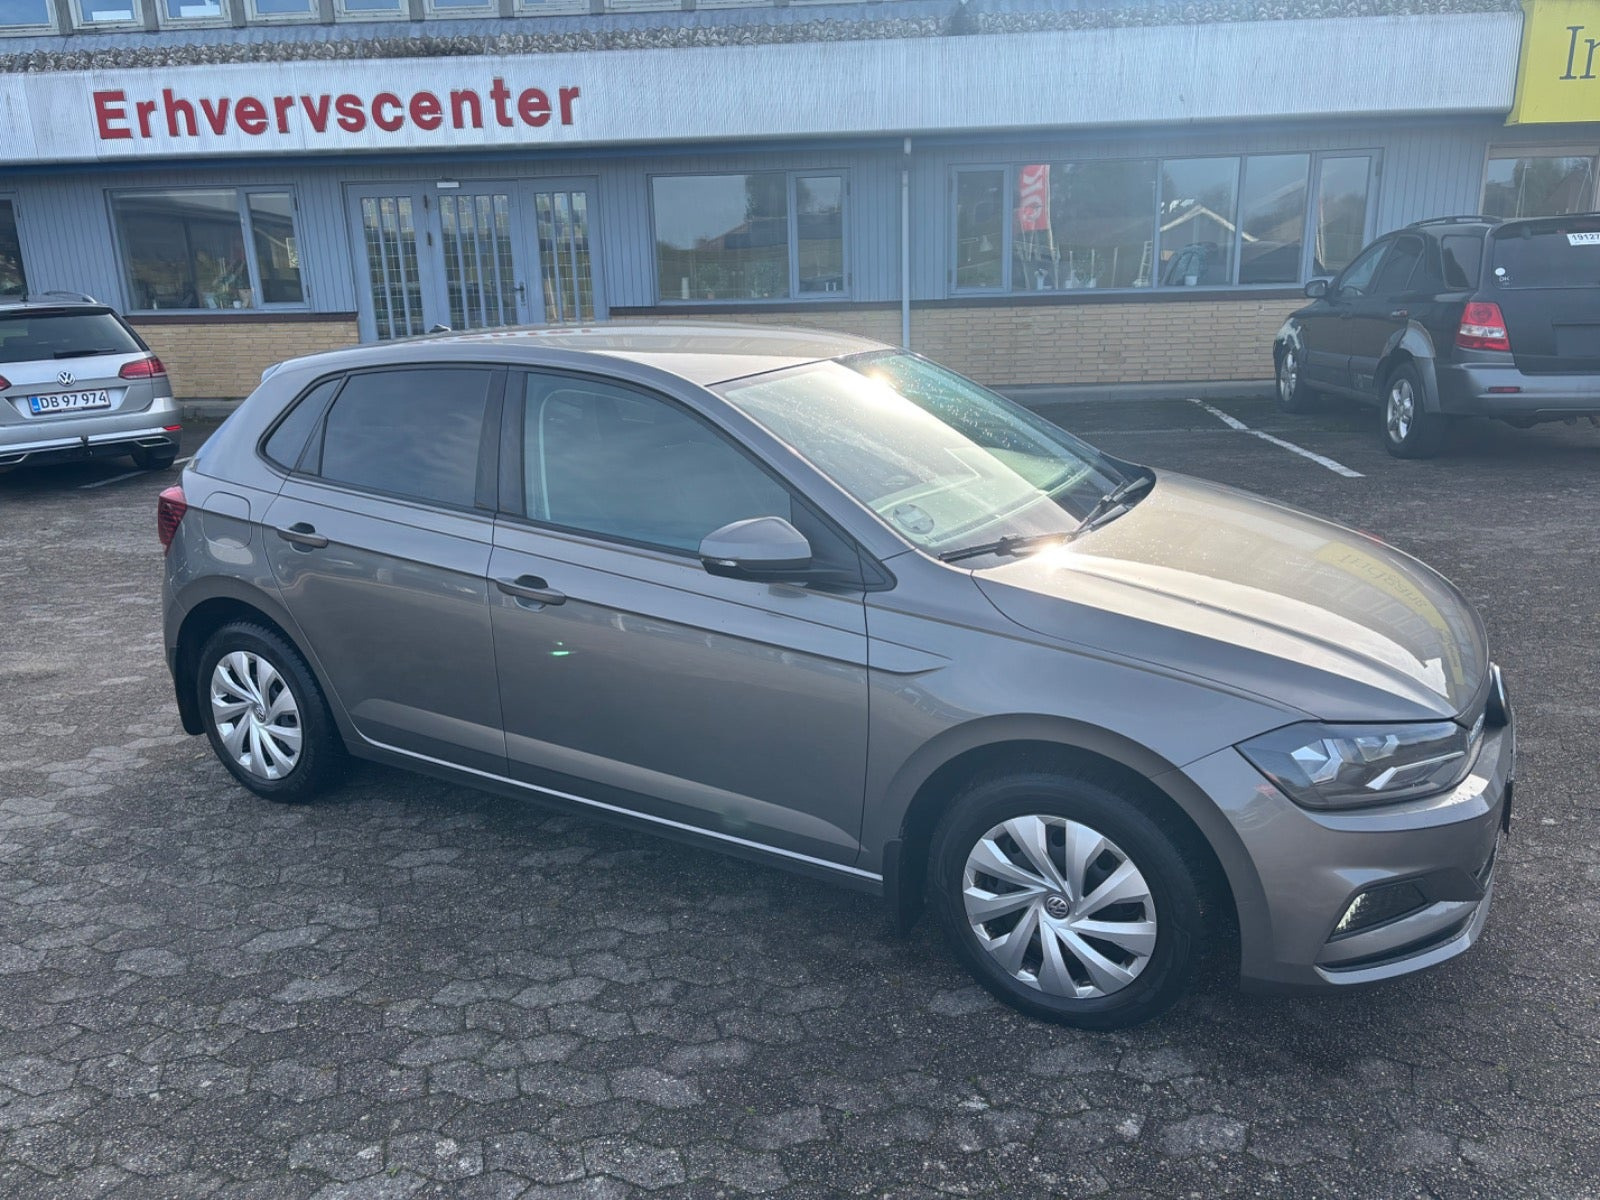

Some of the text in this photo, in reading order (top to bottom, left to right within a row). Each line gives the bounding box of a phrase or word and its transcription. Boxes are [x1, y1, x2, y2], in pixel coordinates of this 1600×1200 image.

[93, 77, 579, 140] Erhvervscenter
[40, 391, 107, 409] DB 97 974
